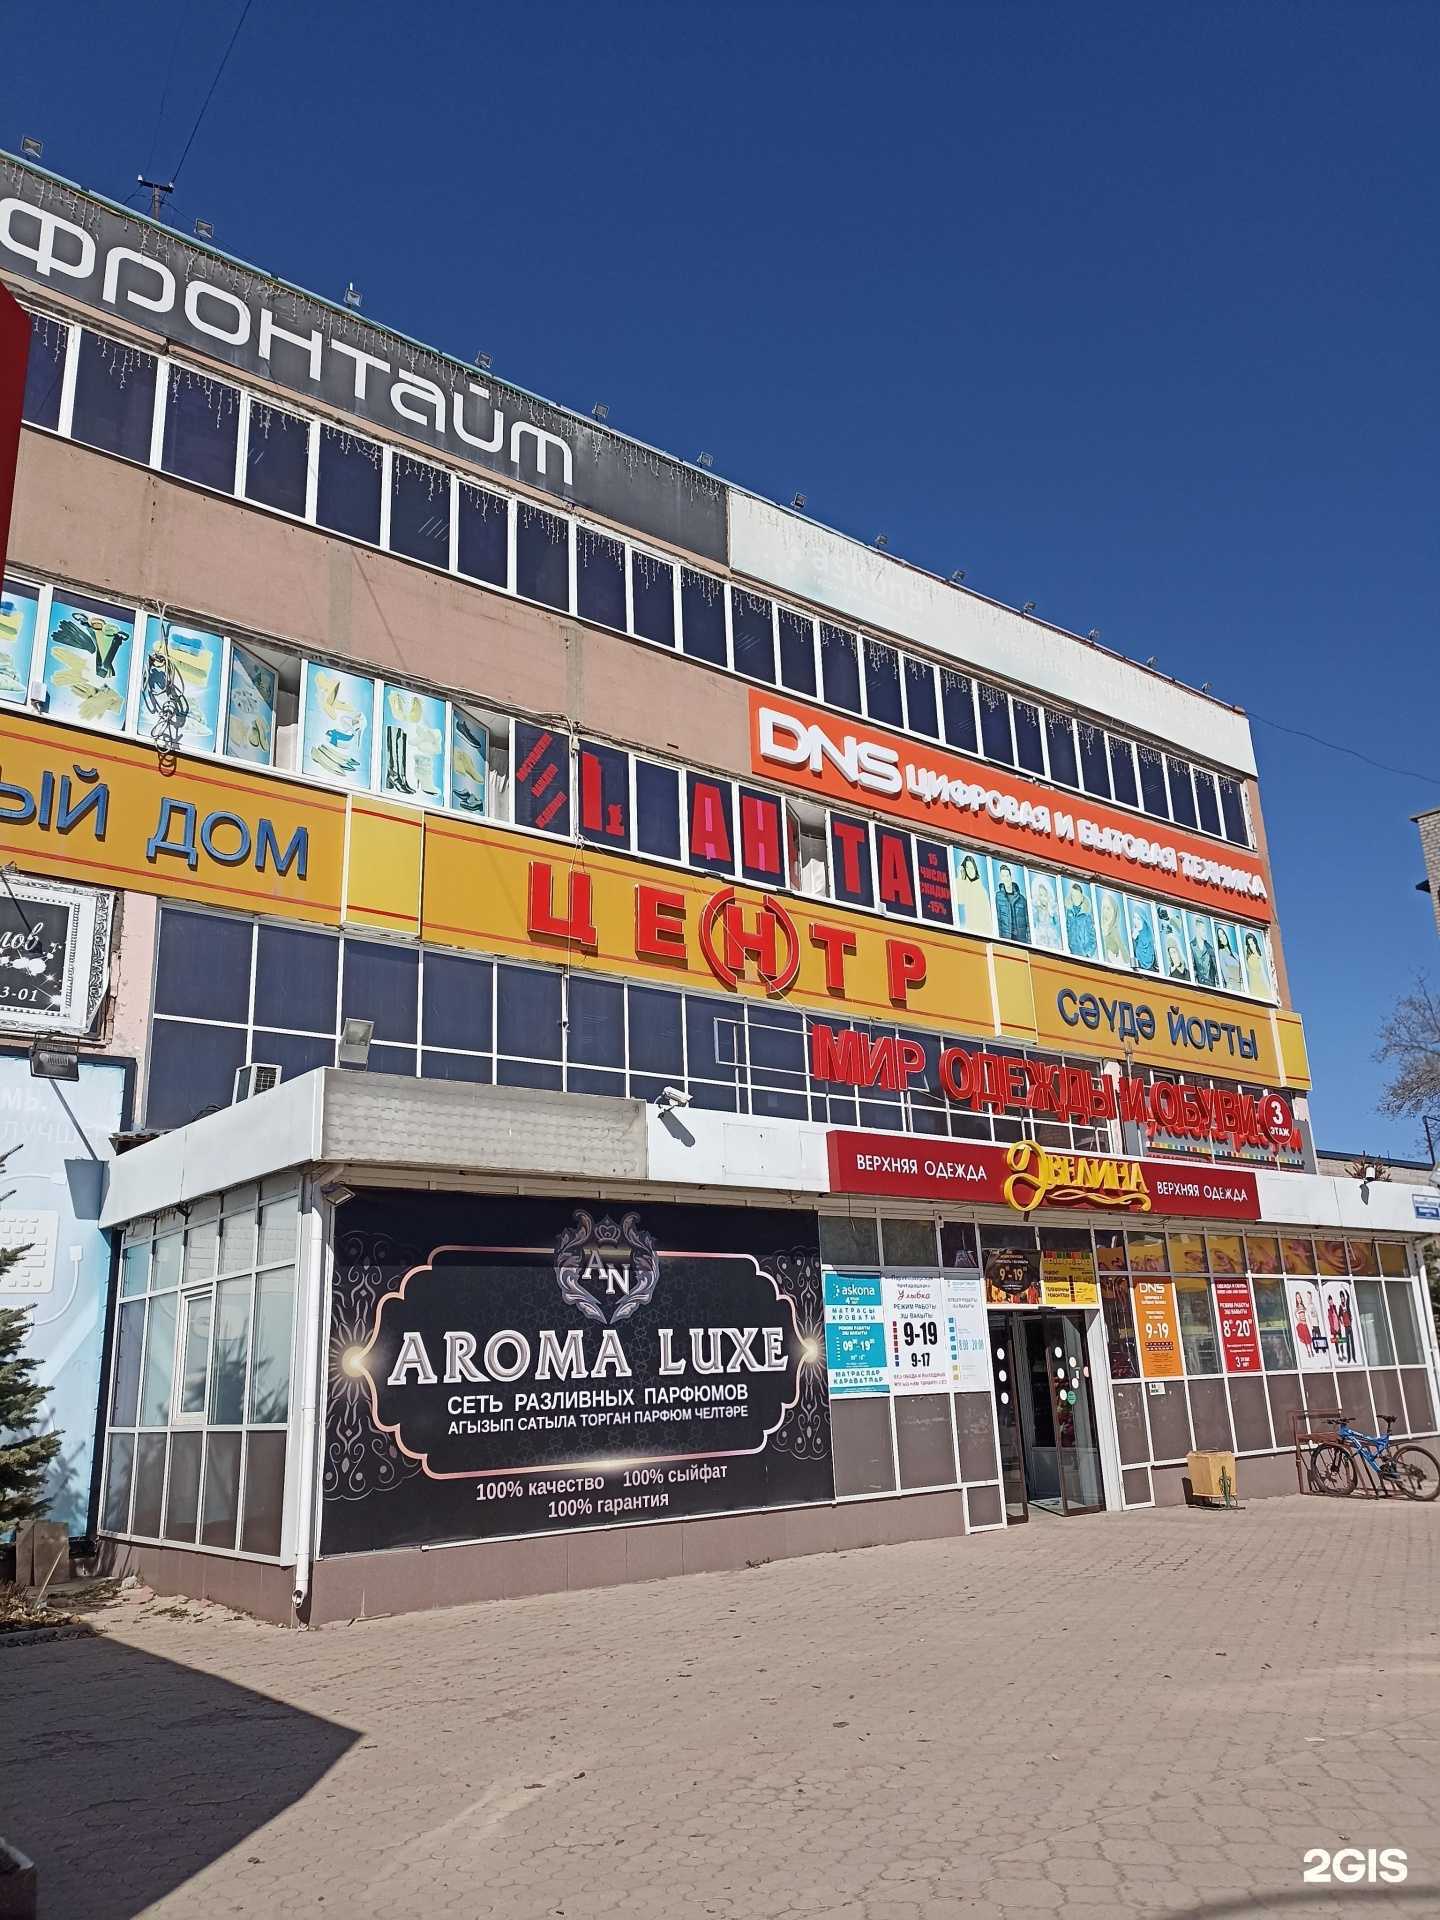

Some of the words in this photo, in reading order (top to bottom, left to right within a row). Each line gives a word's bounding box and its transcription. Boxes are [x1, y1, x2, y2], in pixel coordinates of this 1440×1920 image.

[759, 707, 903, 795] DNS
[146, 796, 308, 881] ДОМ
[904, 764, 1051, 834] ЦИФРОВАЯ
[1053, 811, 1075, 841] И
[1077, 819, 1178, 873] БЫТОВАЯ
[1178, 851, 1268, 899] ТЕХНИКА
[528, 861, 928, 1009] ЦЕНТР
[1167, 1005, 1258, 1061] ЙОРТЫ
[812, 1024, 926, 1092] МИР
[938, 1046, 1118, 1126] ОДЕЖДЫ
[1150, 1081, 1259, 1137] ОБУВИ
[1270, 1101, 1284, 1125] 3
[1269, 1126, 1290, 1137] ЭТАЖ
[856, 1154, 918, 1175] ВЕРХНЯЯ
[924, 1160, 987, 1181] ОДЕЖДА
[1157, 1181, 1200, 1198] ВЕРХНЯЯ
[1203, 1185, 1248, 1202] ОДЕЖДА
[841, 1284, 876, 1296] askona
[1139, 1284, 1165, 1294] DNS
[903, 1321, 938, 1346] 9-19
[1145, 1323, 1169, 1339] 9-19
[387, 1326, 633, 1386] AROMA
[658, 1326, 789, 1376] LUXE
[911, 1352, 931, 1367] 9-17
[447, 1394, 503, 1416] СЕТЬ
[514, 1388, 635, 1412] РАЗЛИВНЫХ
[644, 1383, 749, 1406] ПАРФЮМОВ
[448, 1418, 514, 1435] АГЫЗЫП
[517, 1414, 577, 1431] САТЫЛА
[580, 1412, 631, 1428] ТОРГАН
[634, 1408, 692, 1424] ПАРФЮМ
[694, 1405, 749, 1420] ЧЕЛТӘРЕ
[476, 1480, 524, 1501] 100%
[528, 1476, 605, 1498] качество
[623, 1468, 664, 1487] 100%
[668, 1464, 728, 1485] сыйфат
[548, 1498, 593, 1518] 100%
[597, 1491, 670, 1516] гарантия
